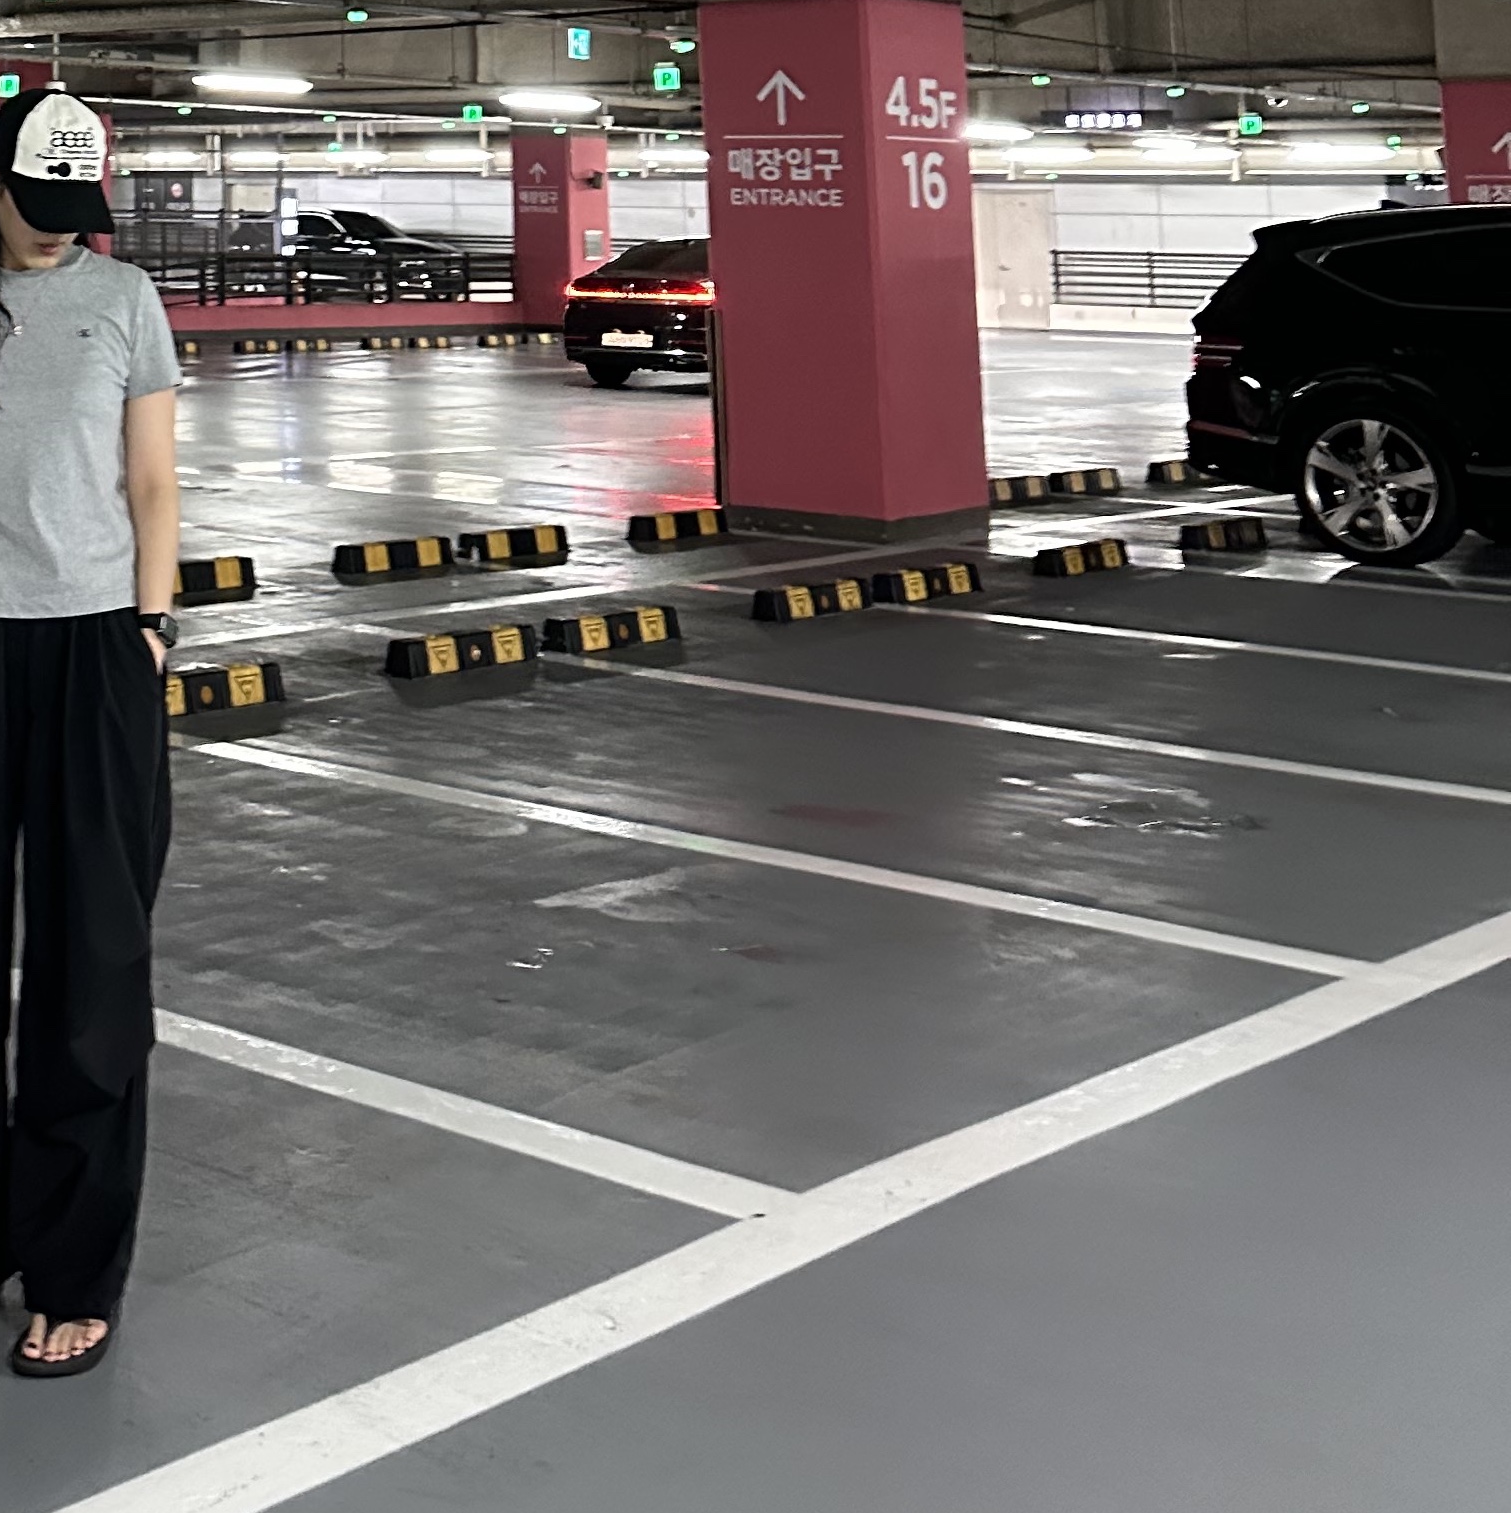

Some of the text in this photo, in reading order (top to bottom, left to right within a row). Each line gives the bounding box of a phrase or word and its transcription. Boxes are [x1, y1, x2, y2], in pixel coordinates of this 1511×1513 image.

[662, 73, 672, 86] P
[886, 76, 958, 129] 4.5F
[727, 147, 844, 182] 매장입구
[901, 151, 948, 210] 16
[730, 187, 845, 207] ENTRANCE
